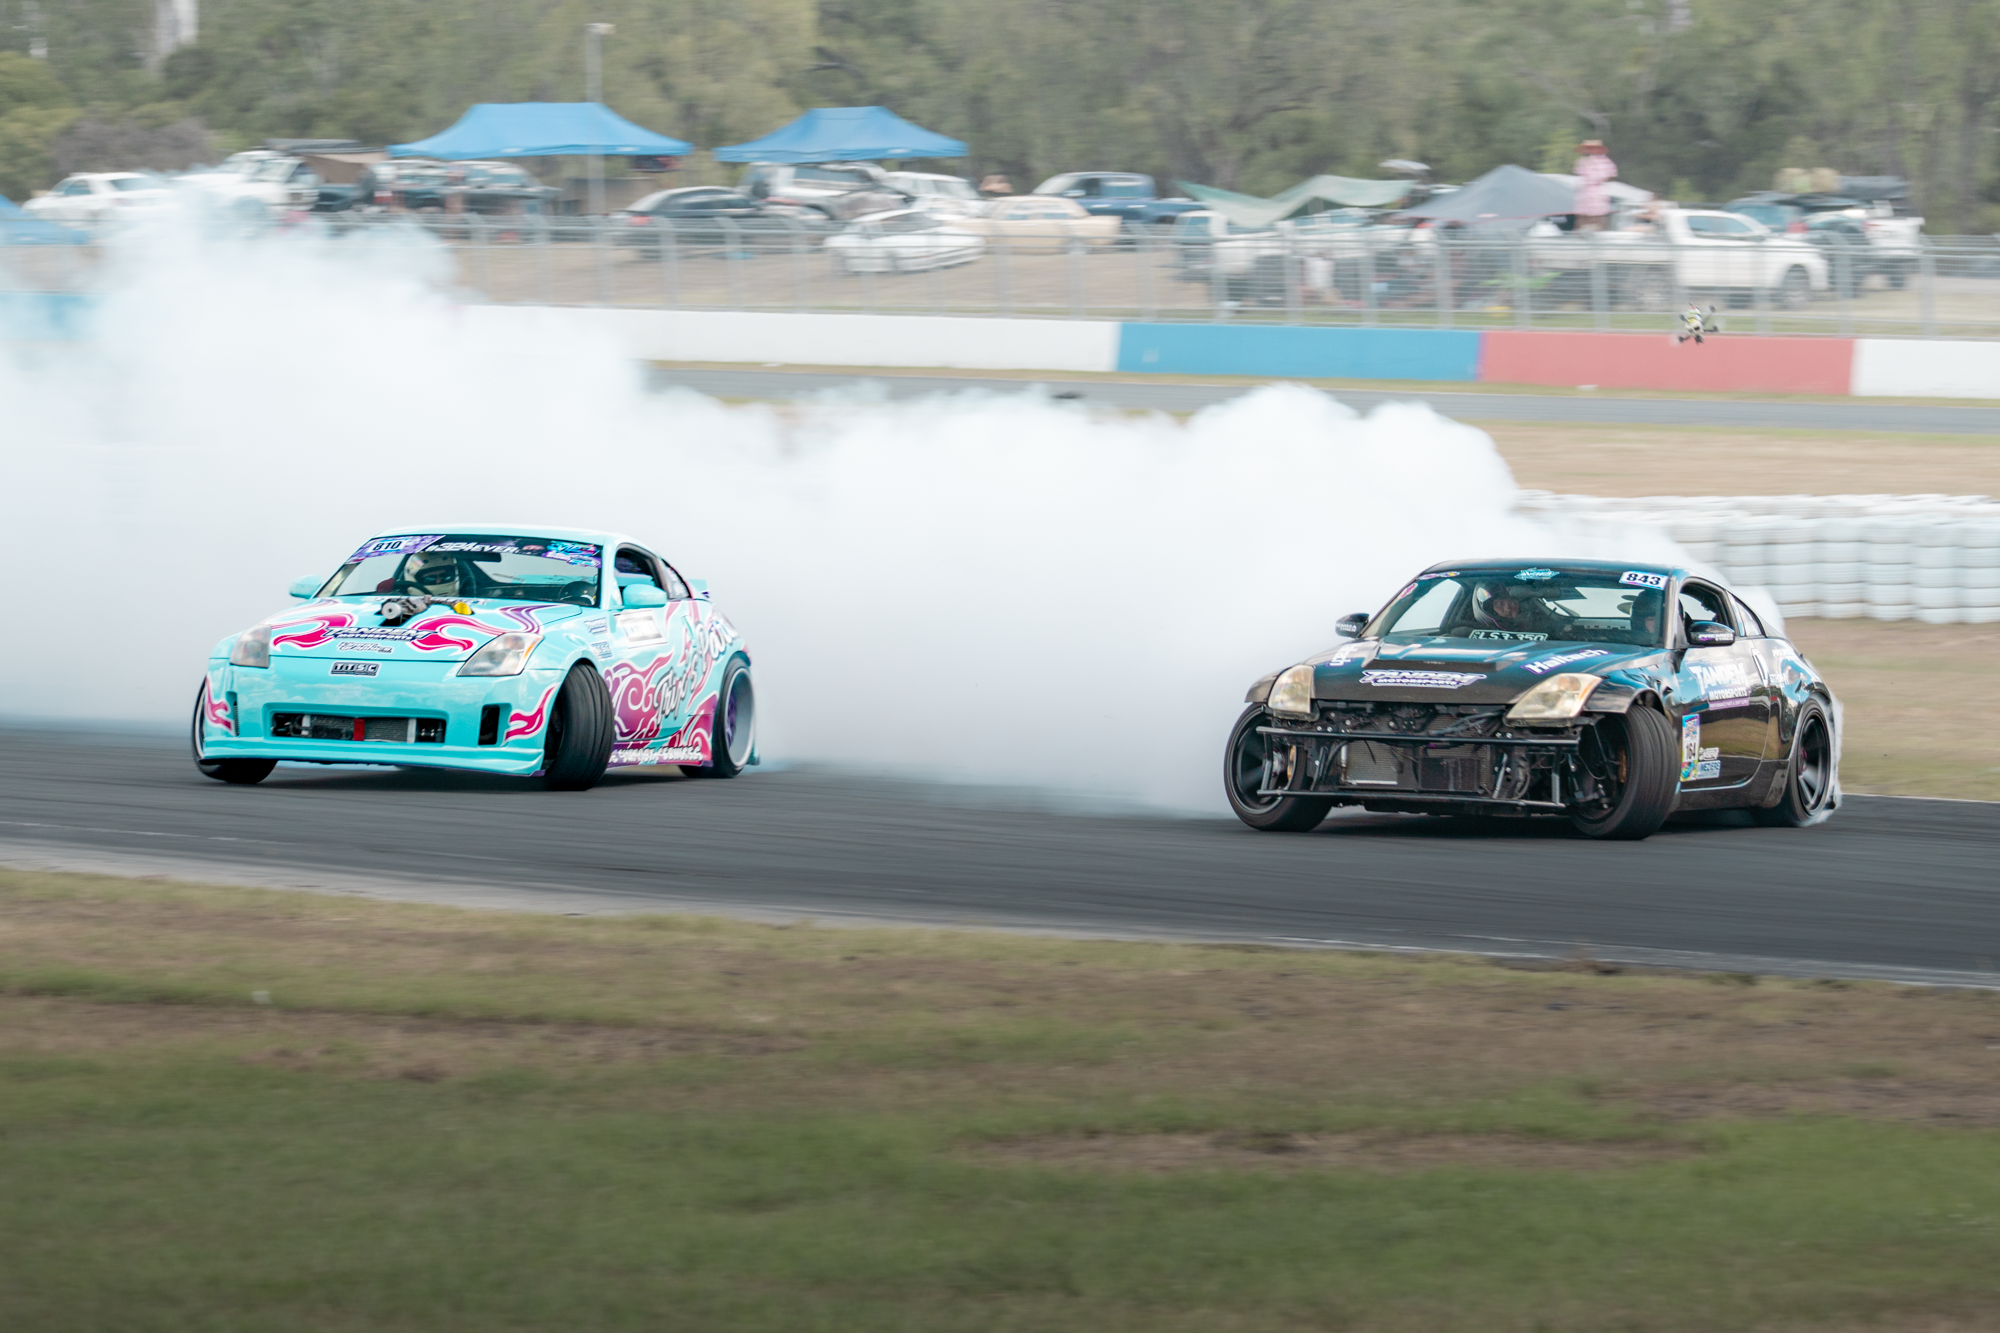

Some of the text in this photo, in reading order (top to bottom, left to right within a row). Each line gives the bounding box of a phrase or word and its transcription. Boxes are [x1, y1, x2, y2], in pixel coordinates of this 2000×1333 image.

[372, 541, 402, 551] 810
[1626, 573, 1661, 585] 843
[322, 627, 438, 640] TANDEM
[1362, 670, 1486, 685] TANDEM
[1688, 662, 1750, 696] TANDEM
[1708, 688, 1748, 700] MOTORSPORTS
